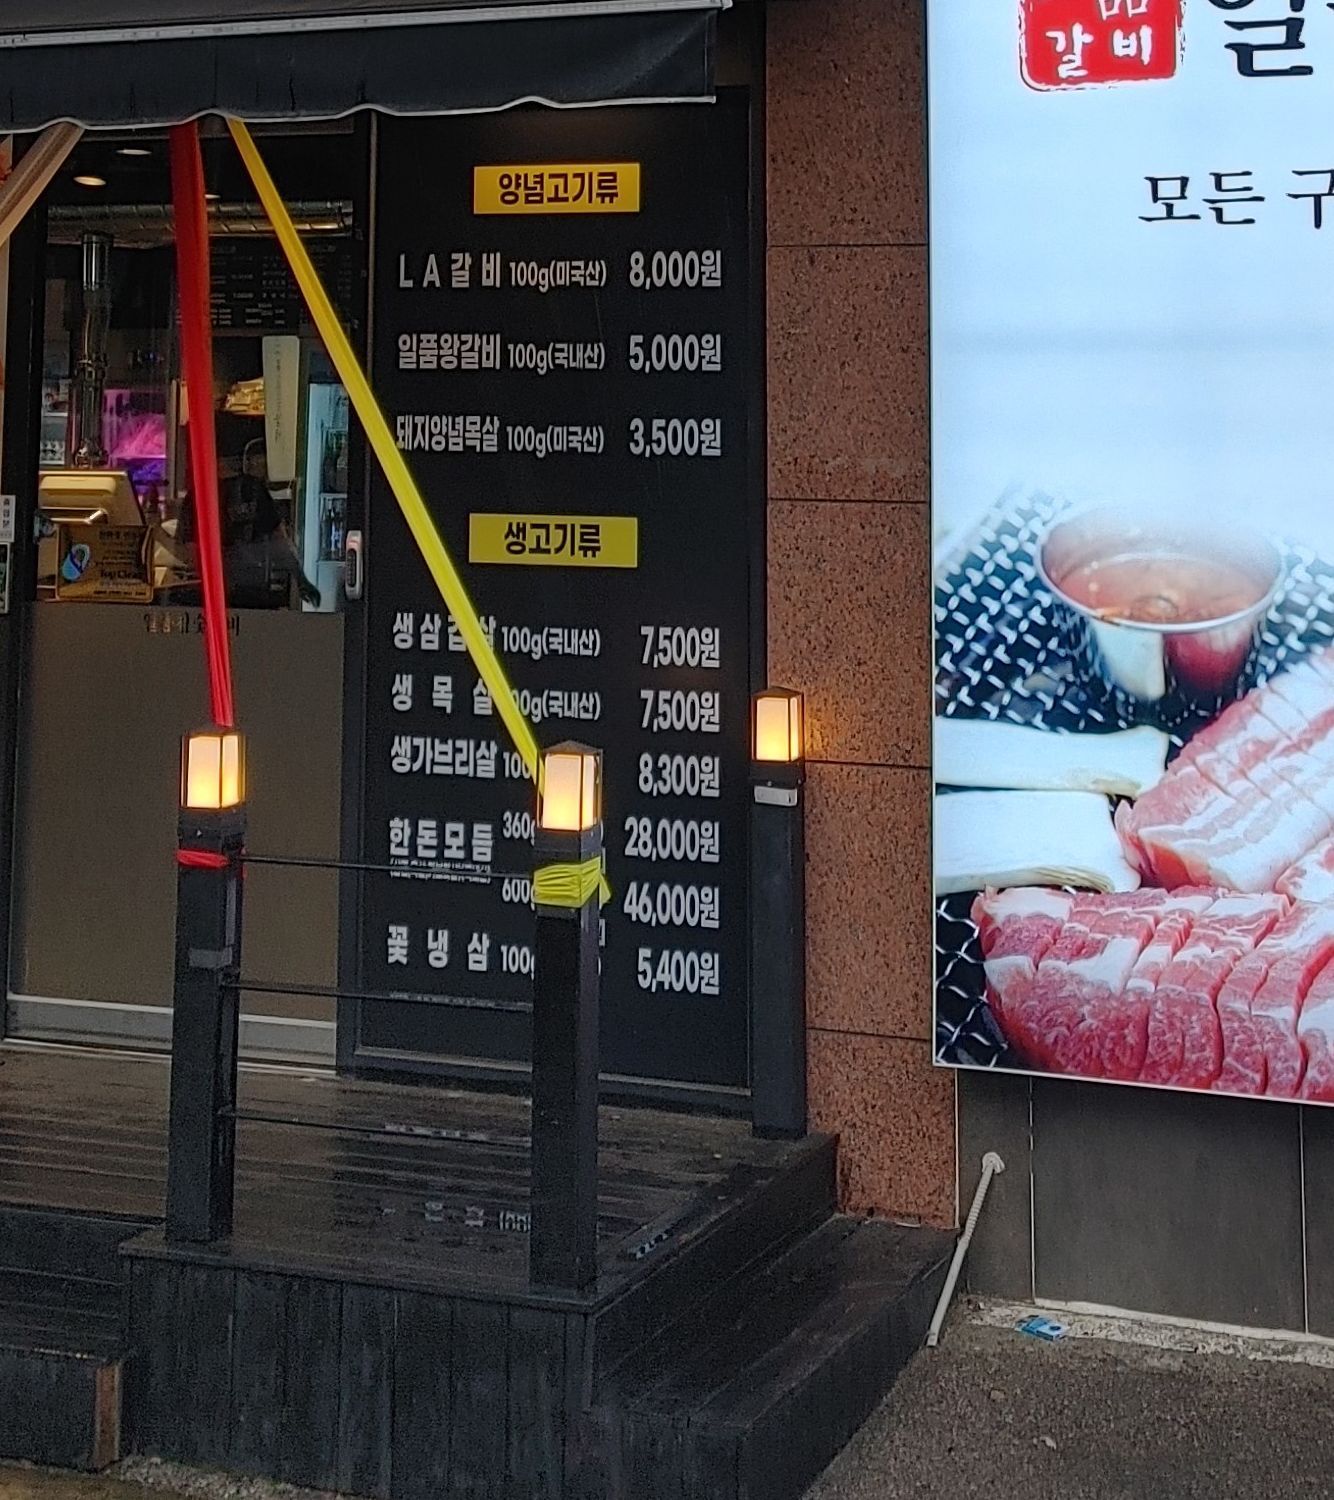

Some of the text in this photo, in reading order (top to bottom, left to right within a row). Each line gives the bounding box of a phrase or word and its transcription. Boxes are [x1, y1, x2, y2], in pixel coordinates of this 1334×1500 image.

[1045, 22, 1154, 79] 갈비
[497, 170, 620, 206] 양념고기류
[1138, 170, 1265, 225] 모든
[508, 258, 607, 294] 100g(미국산)
[628, 249, 722, 291] 8,000원
[397, 333, 722, 375] 일품왕갈비 100g(국내산) 5,000원
[396, 414, 722, 458] 돼지양념목살 100g(미국산) 3,500원
[504, 521, 603, 559] 생고기류
[501, 626, 602, 661] 100g(국내산)
[640, 625, 721, 669] 7,500원
[640, 689, 721, 734] 7,500원
[390, 735, 498, 780] 생가브리살
[638, 752, 721, 798] 8,300원
[624, 816, 721, 864] 28,000원
[623, 881, 721, 930] 46,000원
[637, 948, 721, 996] 5,400원
